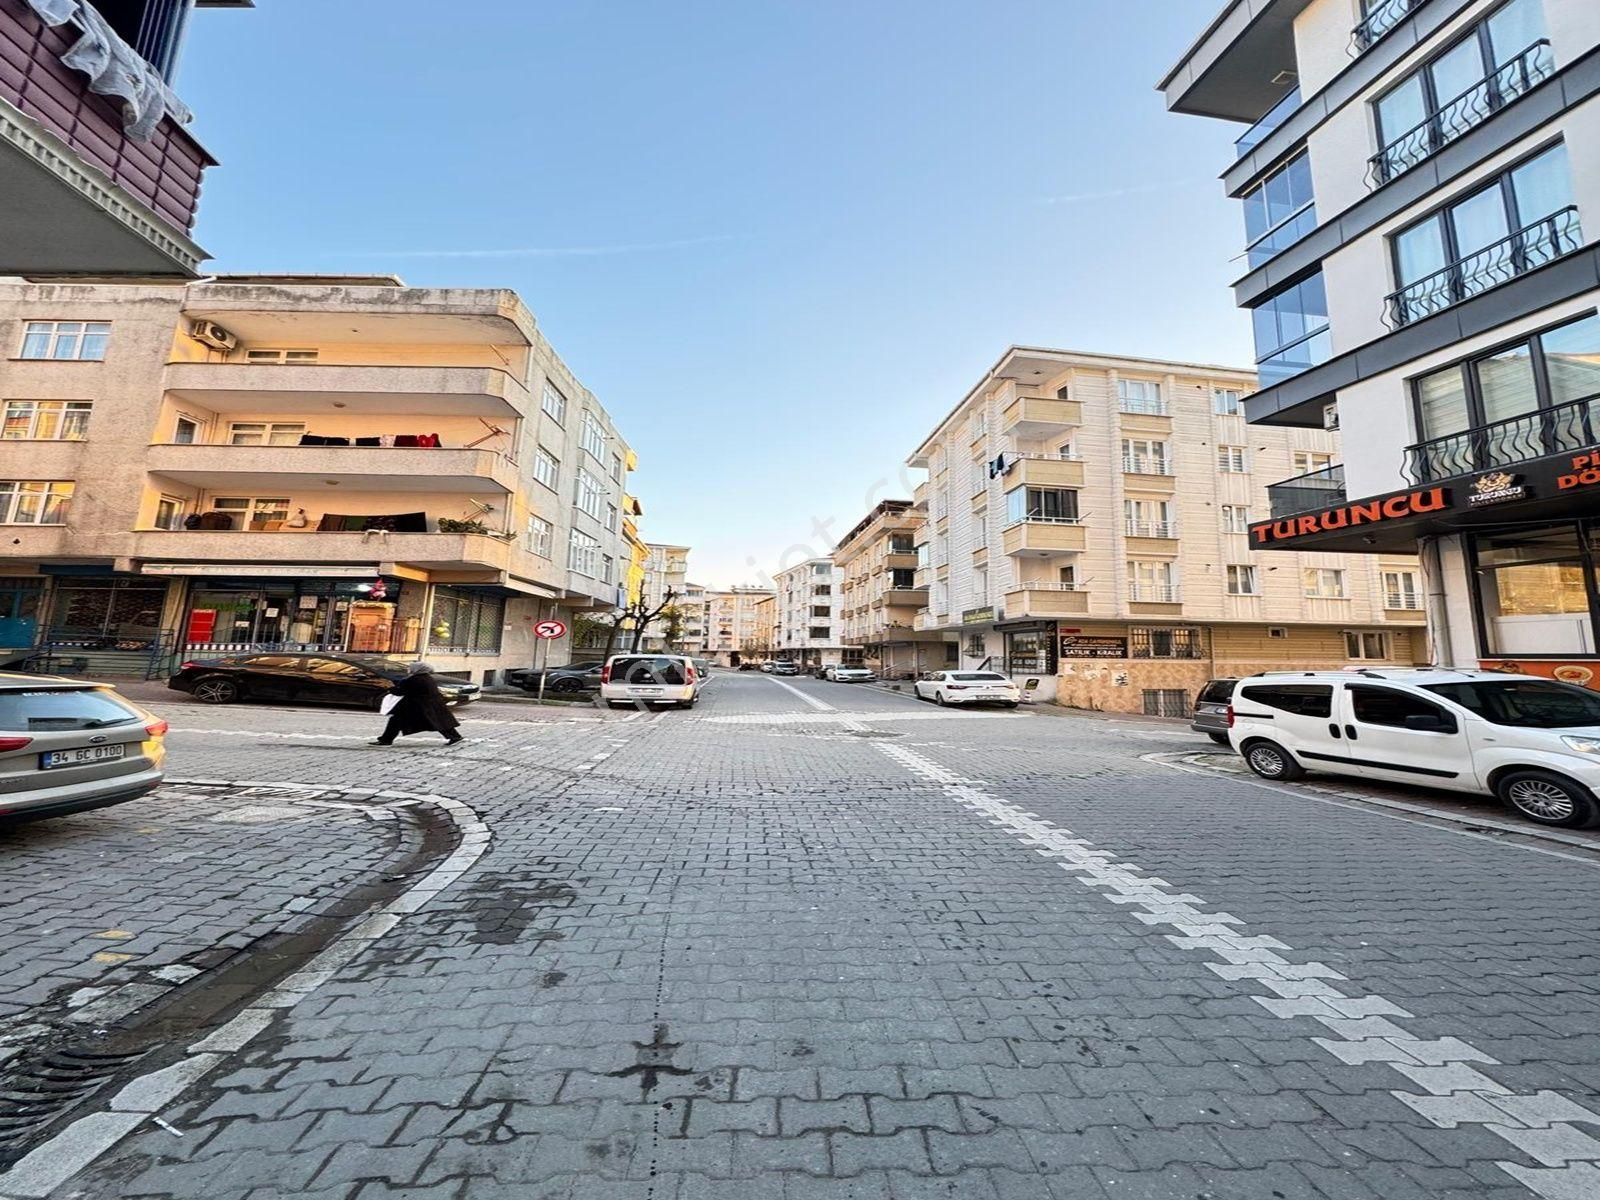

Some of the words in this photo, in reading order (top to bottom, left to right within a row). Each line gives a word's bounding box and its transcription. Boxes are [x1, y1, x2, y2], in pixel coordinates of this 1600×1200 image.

[1253, 487, 1446, 543] TURUNCU
[52, 752, 69, 762] 34
[76, 749, 90, 761] GC
[95, 745, 122, 758] 0100
